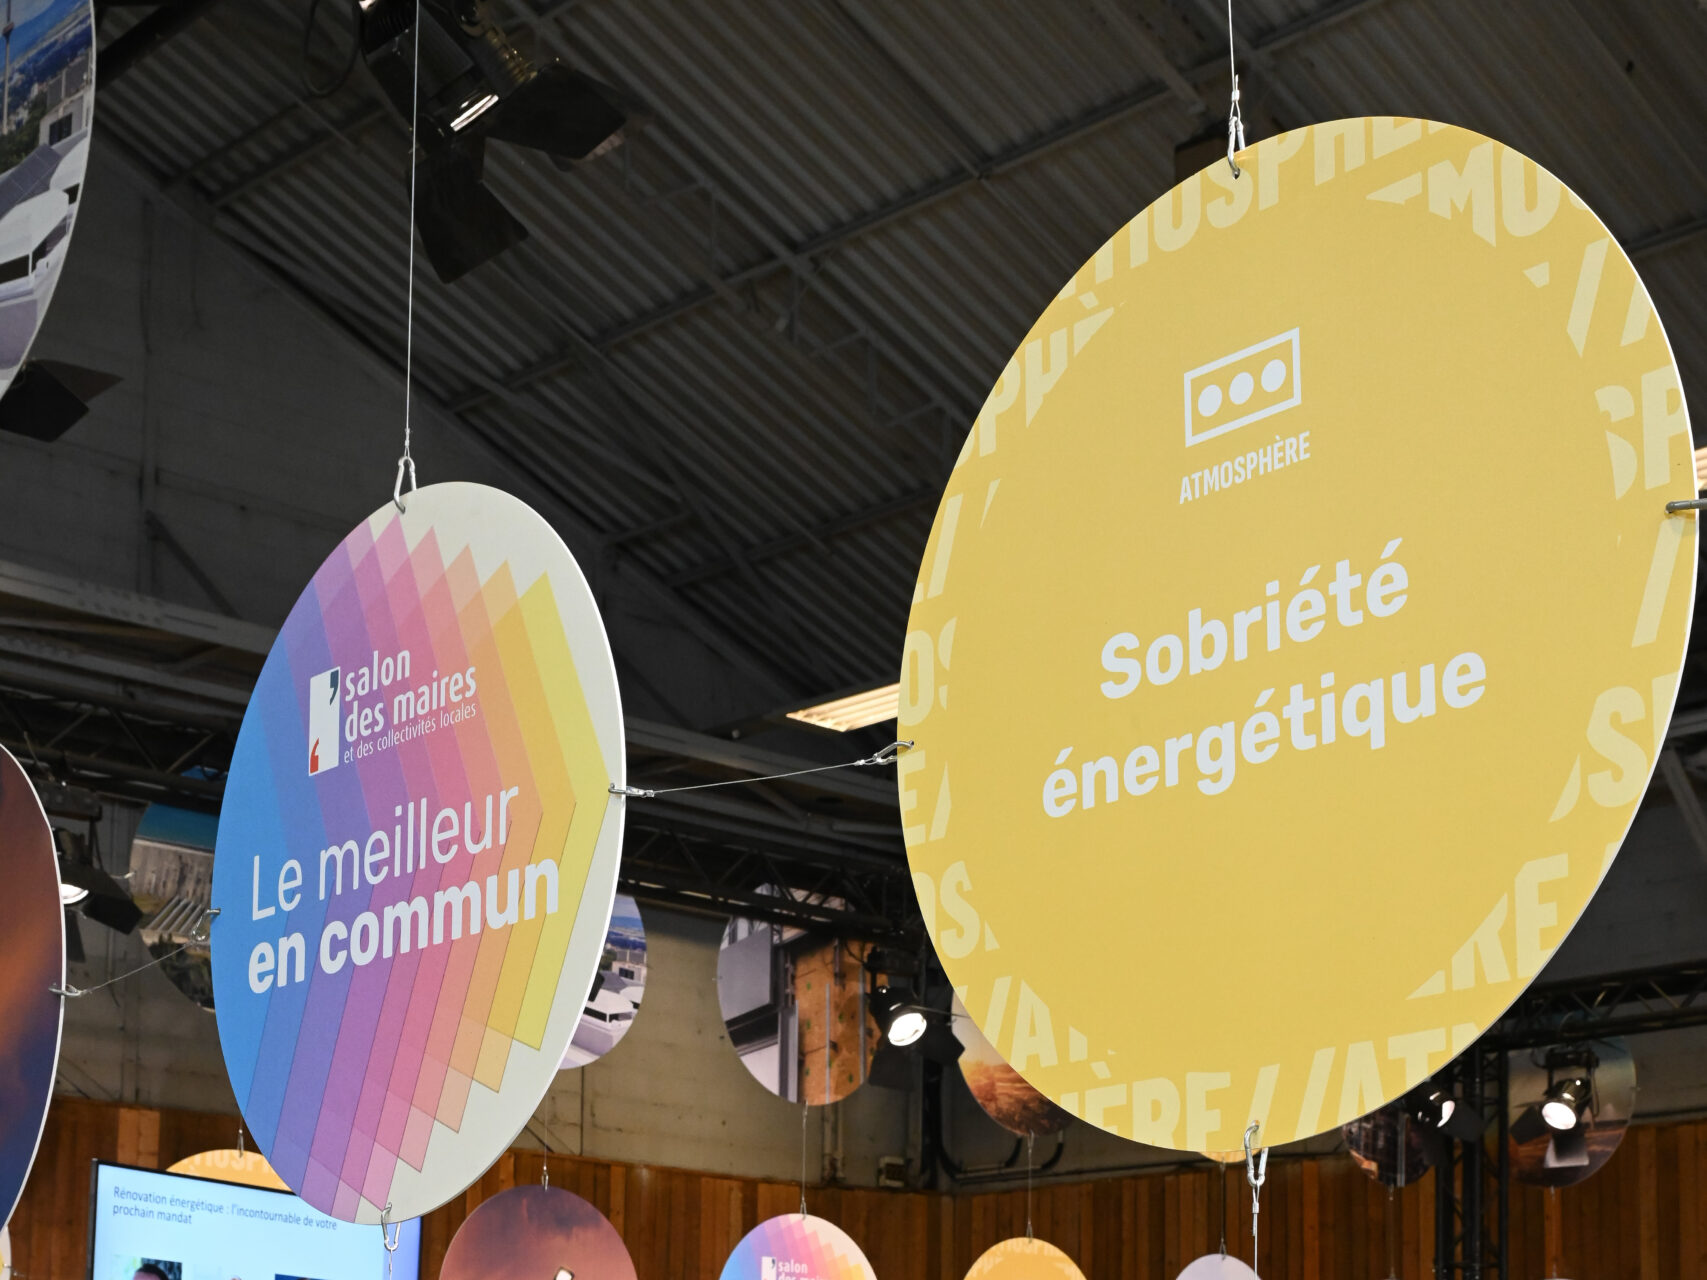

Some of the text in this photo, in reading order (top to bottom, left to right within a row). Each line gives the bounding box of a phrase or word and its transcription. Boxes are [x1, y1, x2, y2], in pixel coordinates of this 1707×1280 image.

[1179, 430, 1311, 505] ATMOSPHÈRE
[1099, 537, 1409, 700] Sobriété
[345, 650, 410, 702] salon
[345, 666, 477, 743] des maires
[344, 703, 477, 764] et des collectivités locales
[1042, 651, 1487, 819] énergétique
[252, 786, 519, 921] Le meilleur
[248, 858, 559, 994] en commun
[112, 1203, 192, 1225] prochain mandat
[113, 1185, 167, 1207] Rénovation
[169, 1193, 224, 1215] énergétique
[304, 1216, 313, 1227] de
[315, 1219, 337, 1231] votre
[778, 1259, 808, 1274] salon
